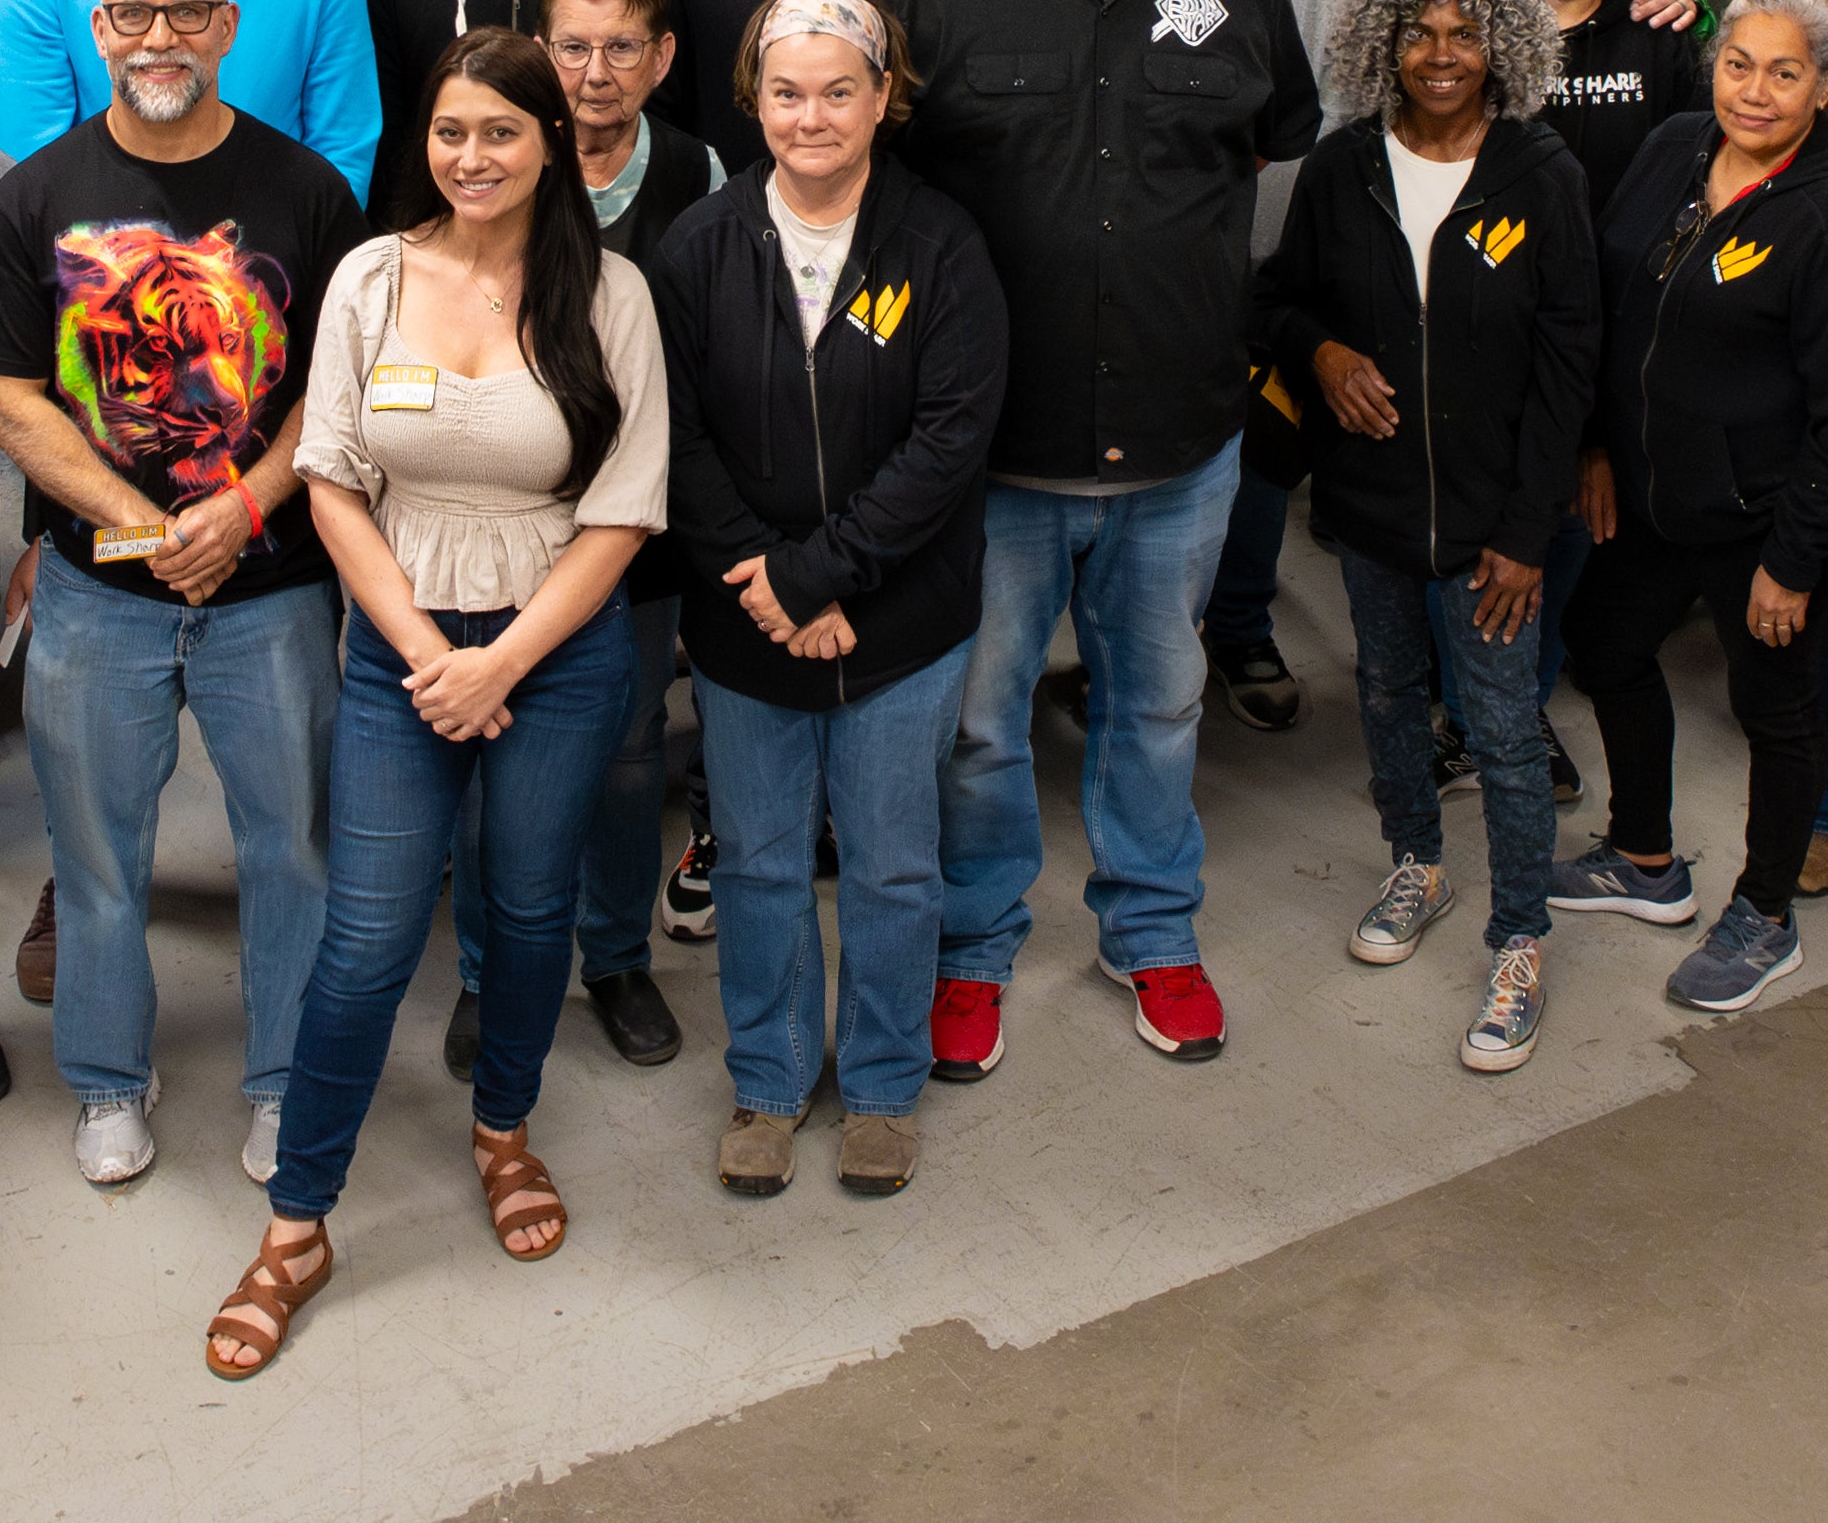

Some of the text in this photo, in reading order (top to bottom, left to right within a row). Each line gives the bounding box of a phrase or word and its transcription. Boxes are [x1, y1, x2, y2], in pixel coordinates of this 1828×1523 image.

[1573, 72, 1642, 95] SHARP
[1541, 92, 1644, 107] APNERS
[378, 368, 430, 382] HELLO I'M
[103, 527, 158, 542] HELLO I'M
[98, 541, 124, 557] Work
